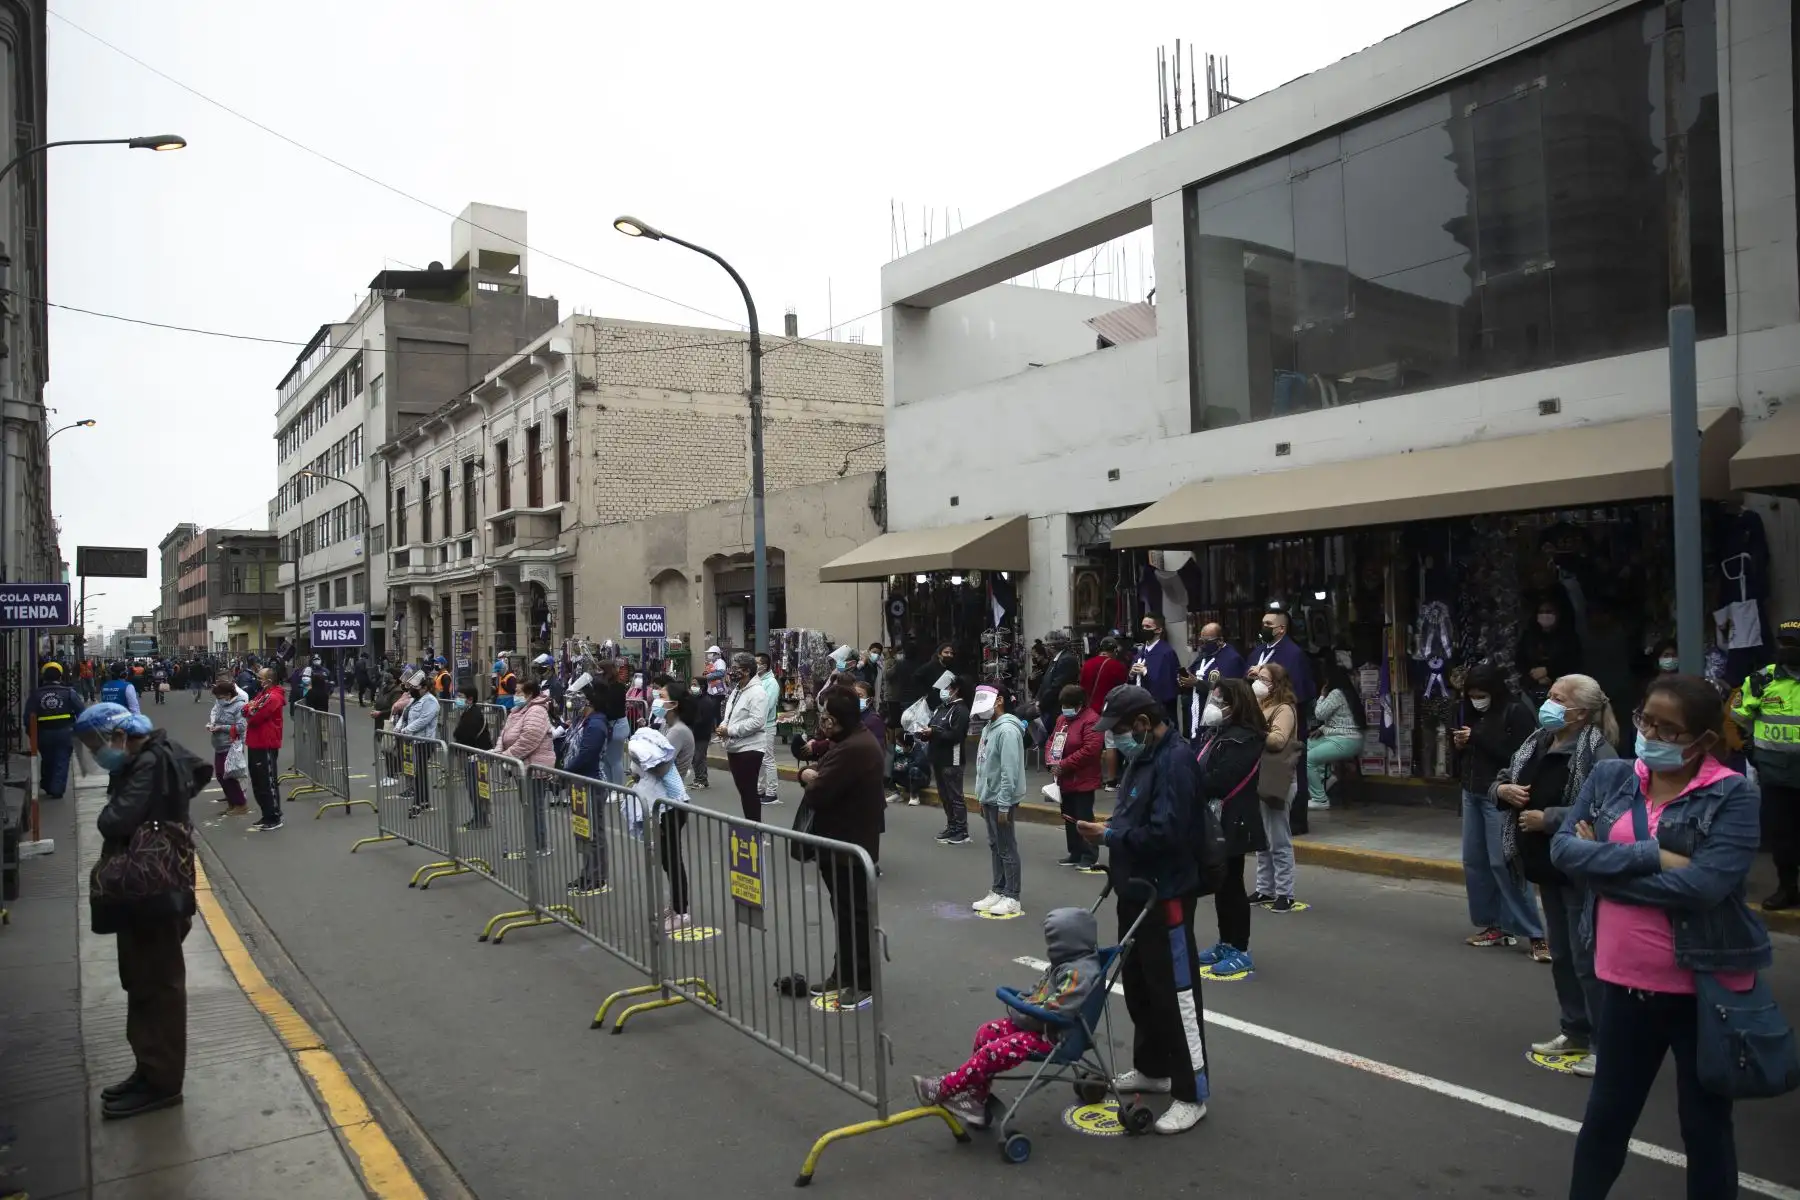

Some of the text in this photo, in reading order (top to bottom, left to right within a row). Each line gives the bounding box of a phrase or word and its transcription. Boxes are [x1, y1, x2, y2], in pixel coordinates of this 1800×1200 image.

[0, 593, 62, 602] COLA PARA
[4, 605, 58, 619] TIENDA
[626, 620, 663, 632] ORACIÓN
[320, 629, 357, 640] MISA
